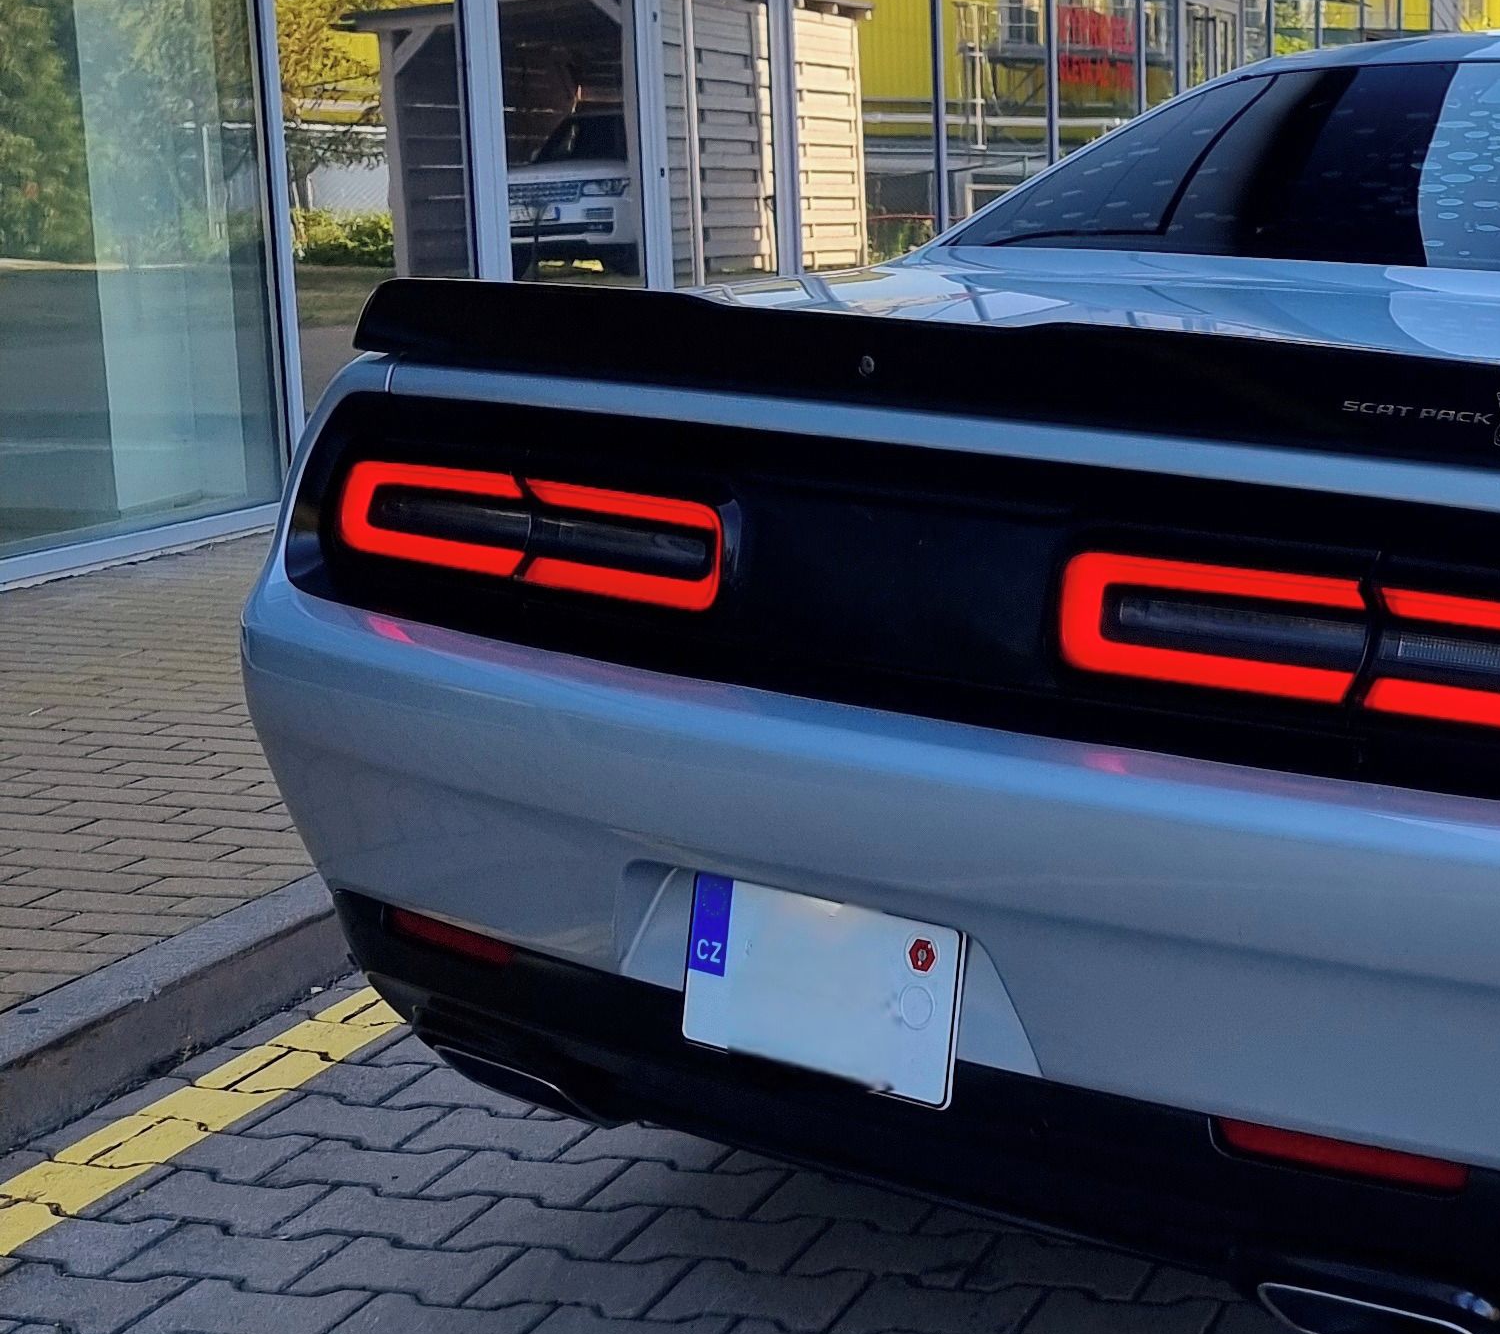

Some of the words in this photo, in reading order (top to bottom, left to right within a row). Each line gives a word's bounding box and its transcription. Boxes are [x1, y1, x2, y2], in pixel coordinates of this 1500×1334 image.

[1342, 400, 1413, 417] SCAT
[1419, 408, 1495, 425] PACK
[696, 938, 722, 964] CZ
